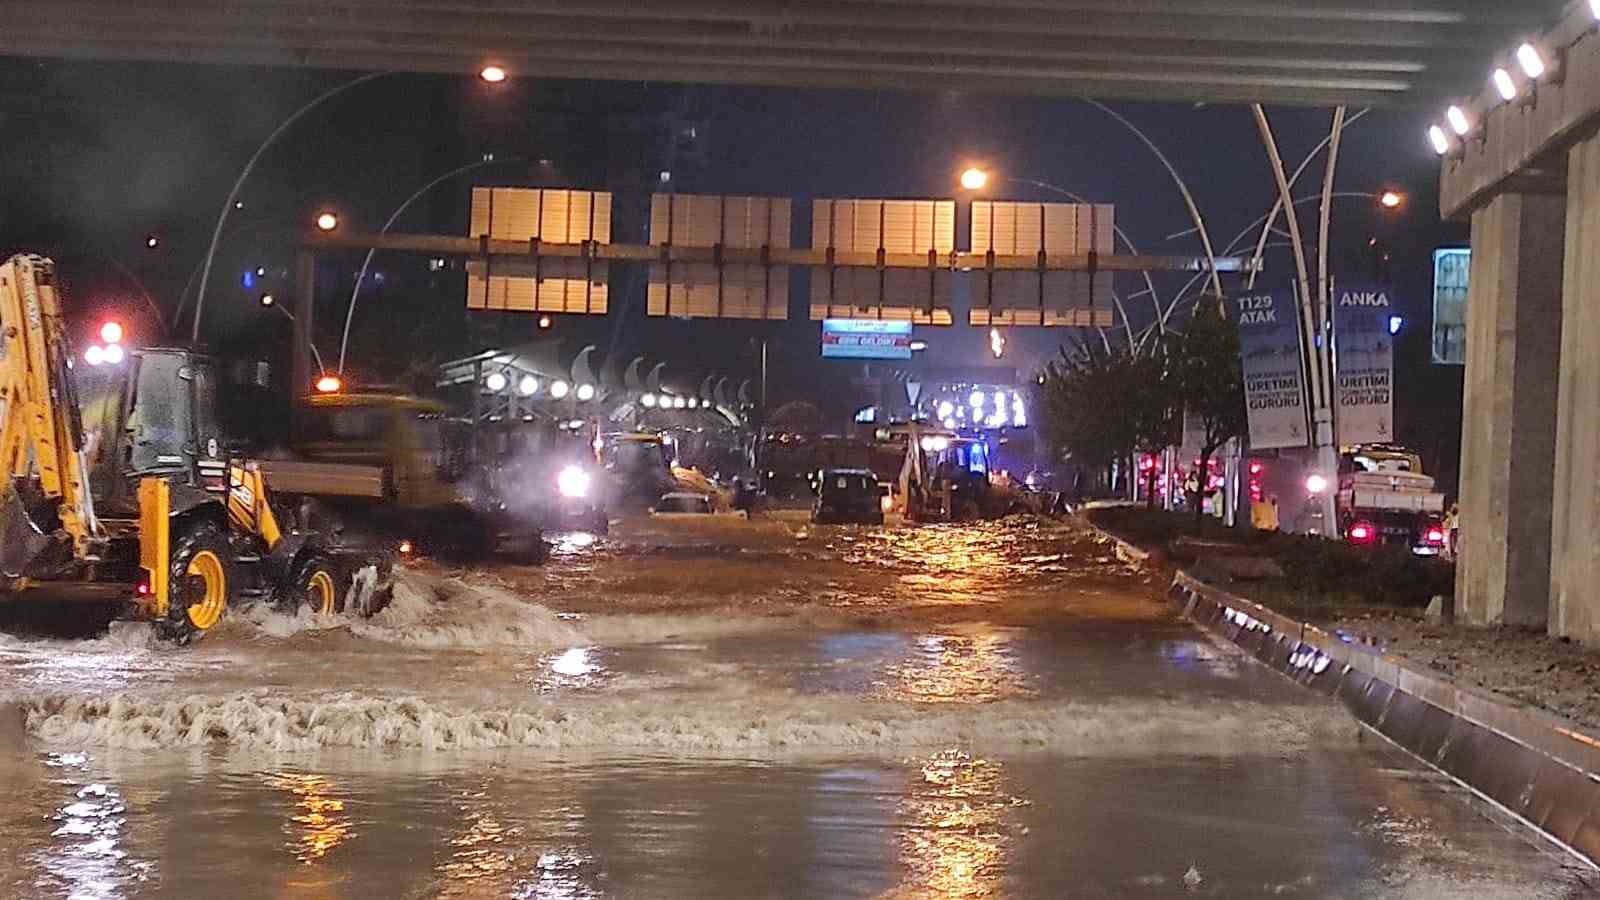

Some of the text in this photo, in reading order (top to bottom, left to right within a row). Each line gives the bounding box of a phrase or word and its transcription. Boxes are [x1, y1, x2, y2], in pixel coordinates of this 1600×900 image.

[1238, 295, 1273, 310] T129
[1340, 292, 1389, 307] ANKA
[1239, 309, 1277, 325] ATAK
